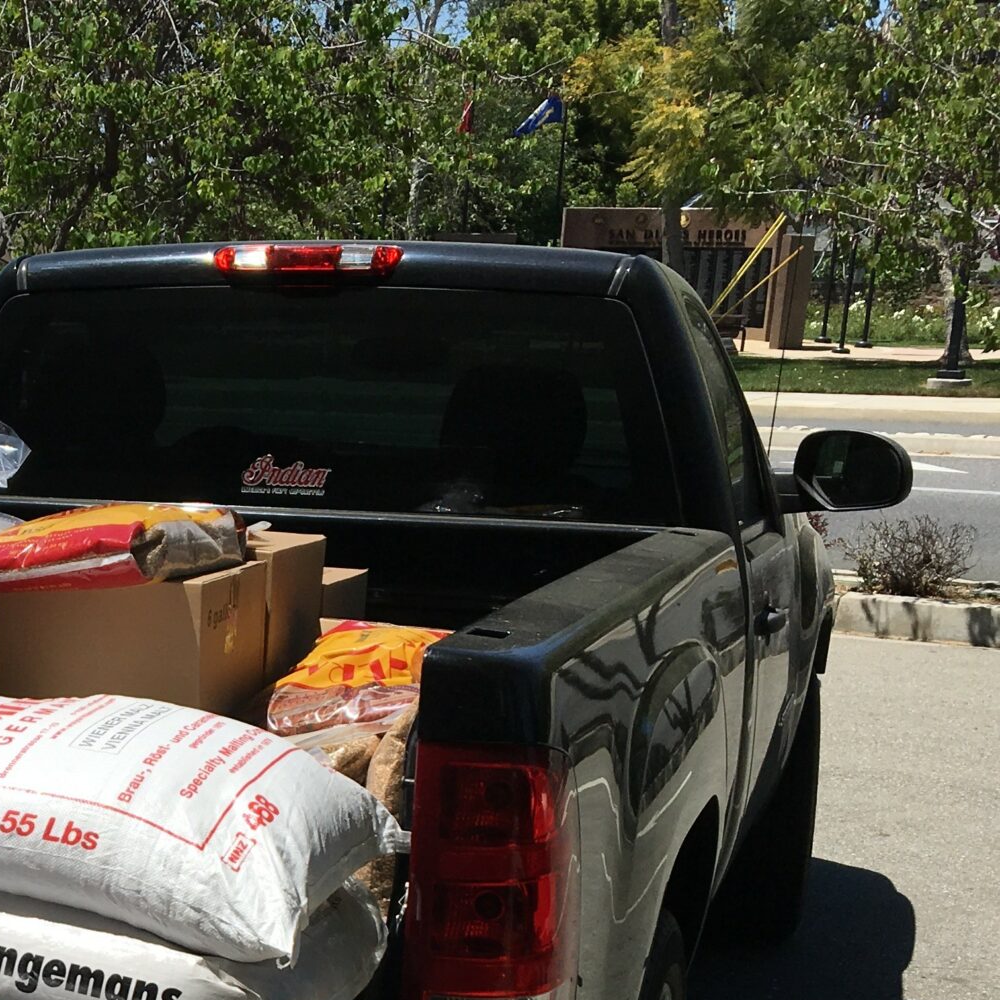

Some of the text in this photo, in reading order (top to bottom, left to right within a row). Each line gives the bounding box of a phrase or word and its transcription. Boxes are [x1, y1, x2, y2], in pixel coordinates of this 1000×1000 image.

[241, 453, 328, 488] Indian
[78, 715, 123, 748] WIENER
[100, 718, 147, 751] VIENNA
[170, 727, 190, 745] und
[179, 754, 227, 799] Specialty
[219, 731, 255, 758] Malting
[41, 816, 100, 851] Lbs
